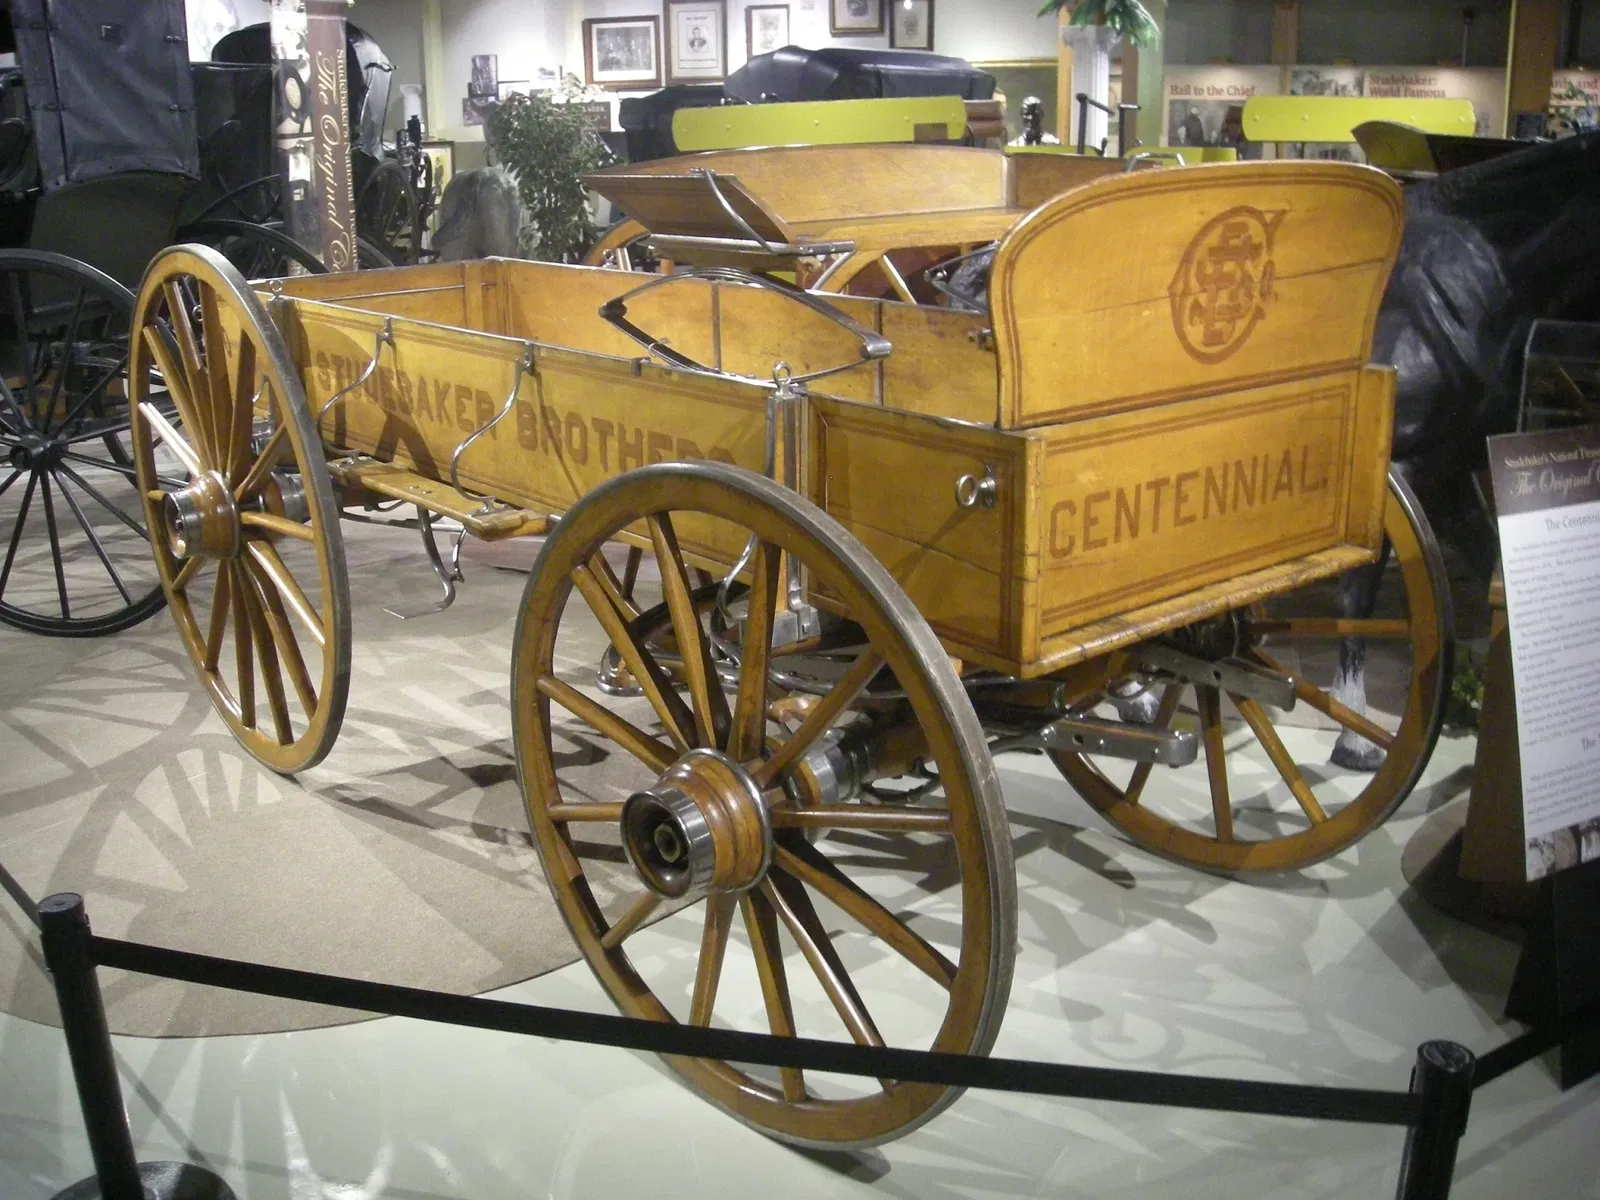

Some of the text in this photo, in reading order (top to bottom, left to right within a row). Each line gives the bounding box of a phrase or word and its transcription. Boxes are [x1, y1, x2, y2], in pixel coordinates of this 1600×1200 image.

[316, 51, 338, 105] The
[1170, 84, 1256, 96] Hail to the Chief
[316, 114, 345, 230] Original
[343, 142, 355, 201] National
[316, 350, 496, 441] STUDEBAKER
